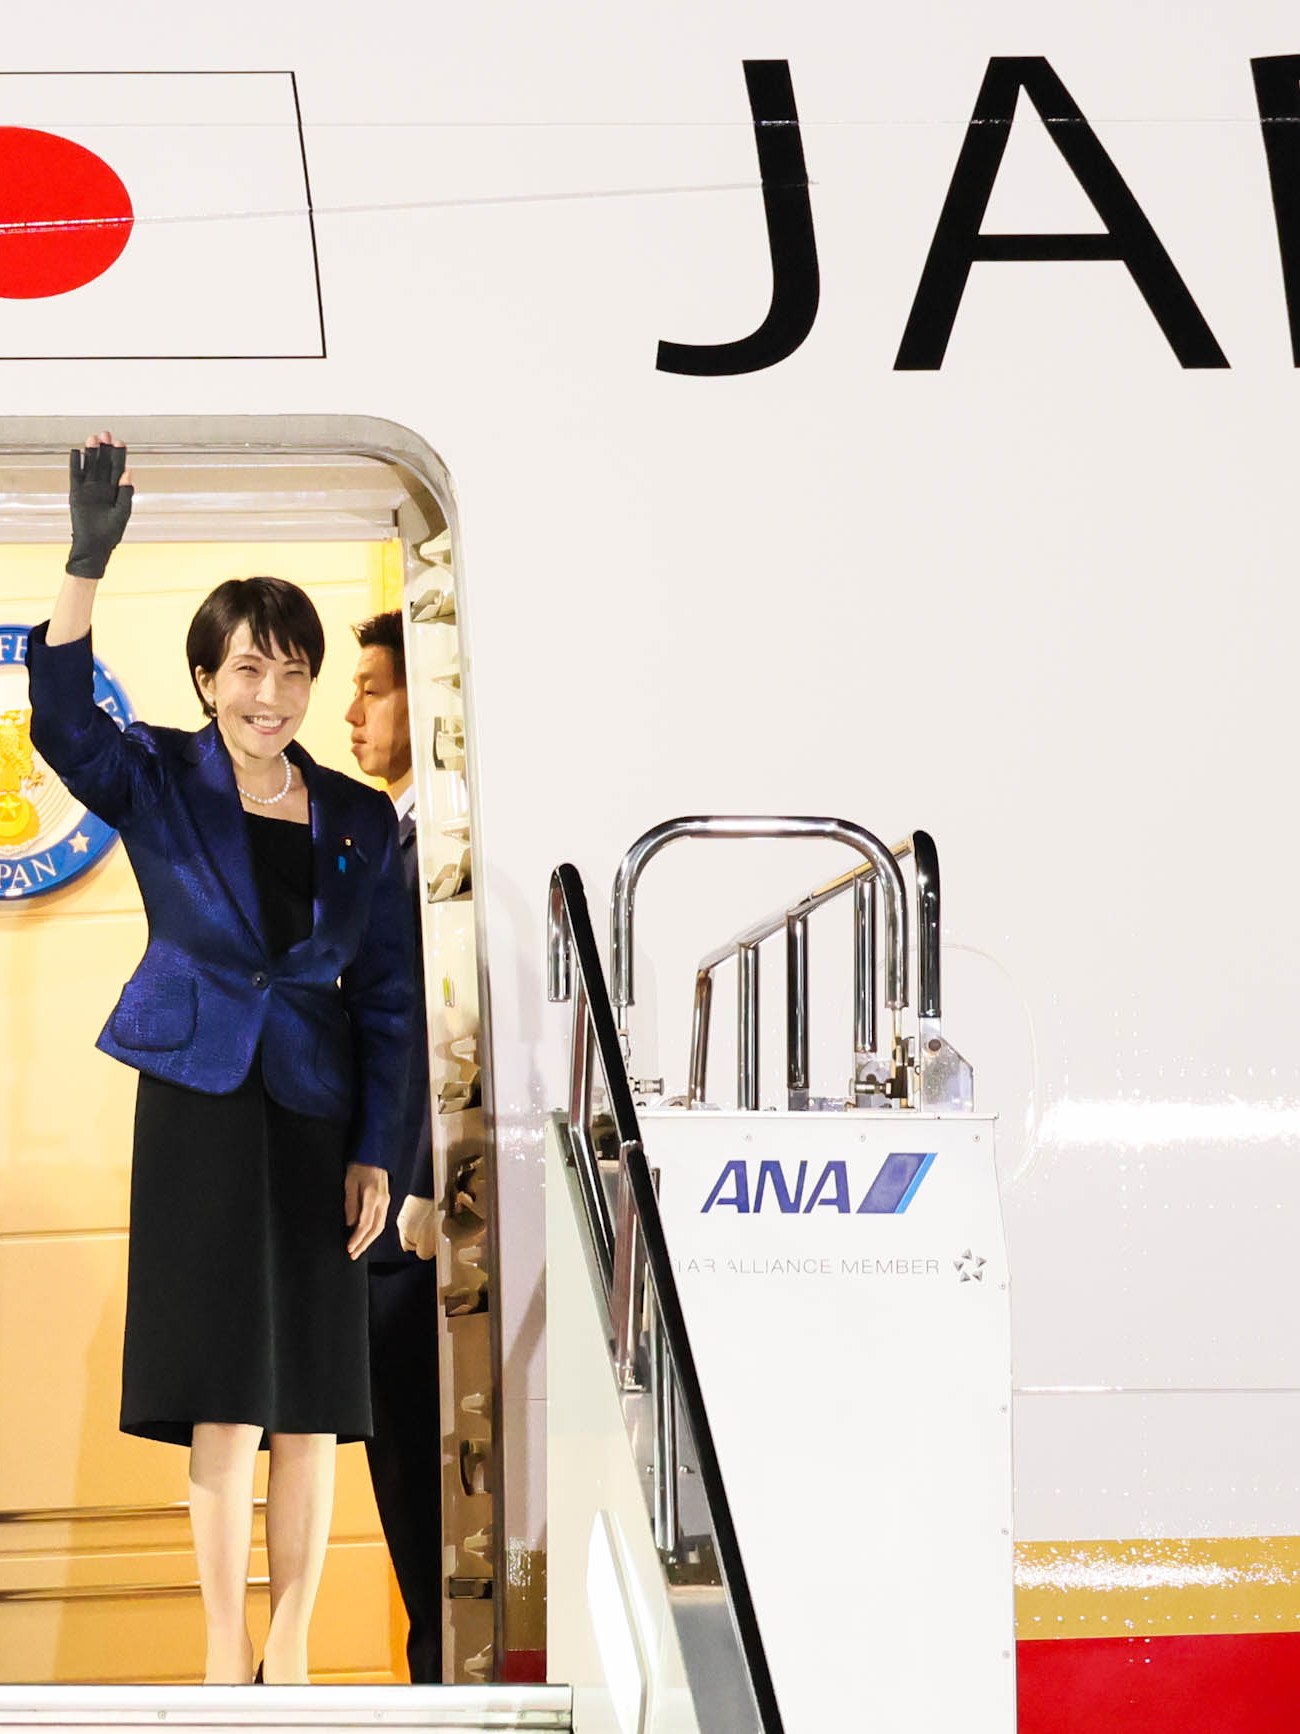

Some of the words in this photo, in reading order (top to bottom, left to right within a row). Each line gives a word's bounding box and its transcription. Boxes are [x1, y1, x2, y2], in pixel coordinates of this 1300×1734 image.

[655, 55, 1300, 377] JA
[700, 1160, 851, 1214] ANA
[673, 1258, 716, 1273] TAR
[727, 1258, 832, 1274] ALLIANCE
[842, 1259, 939, 1275] MEMBER
